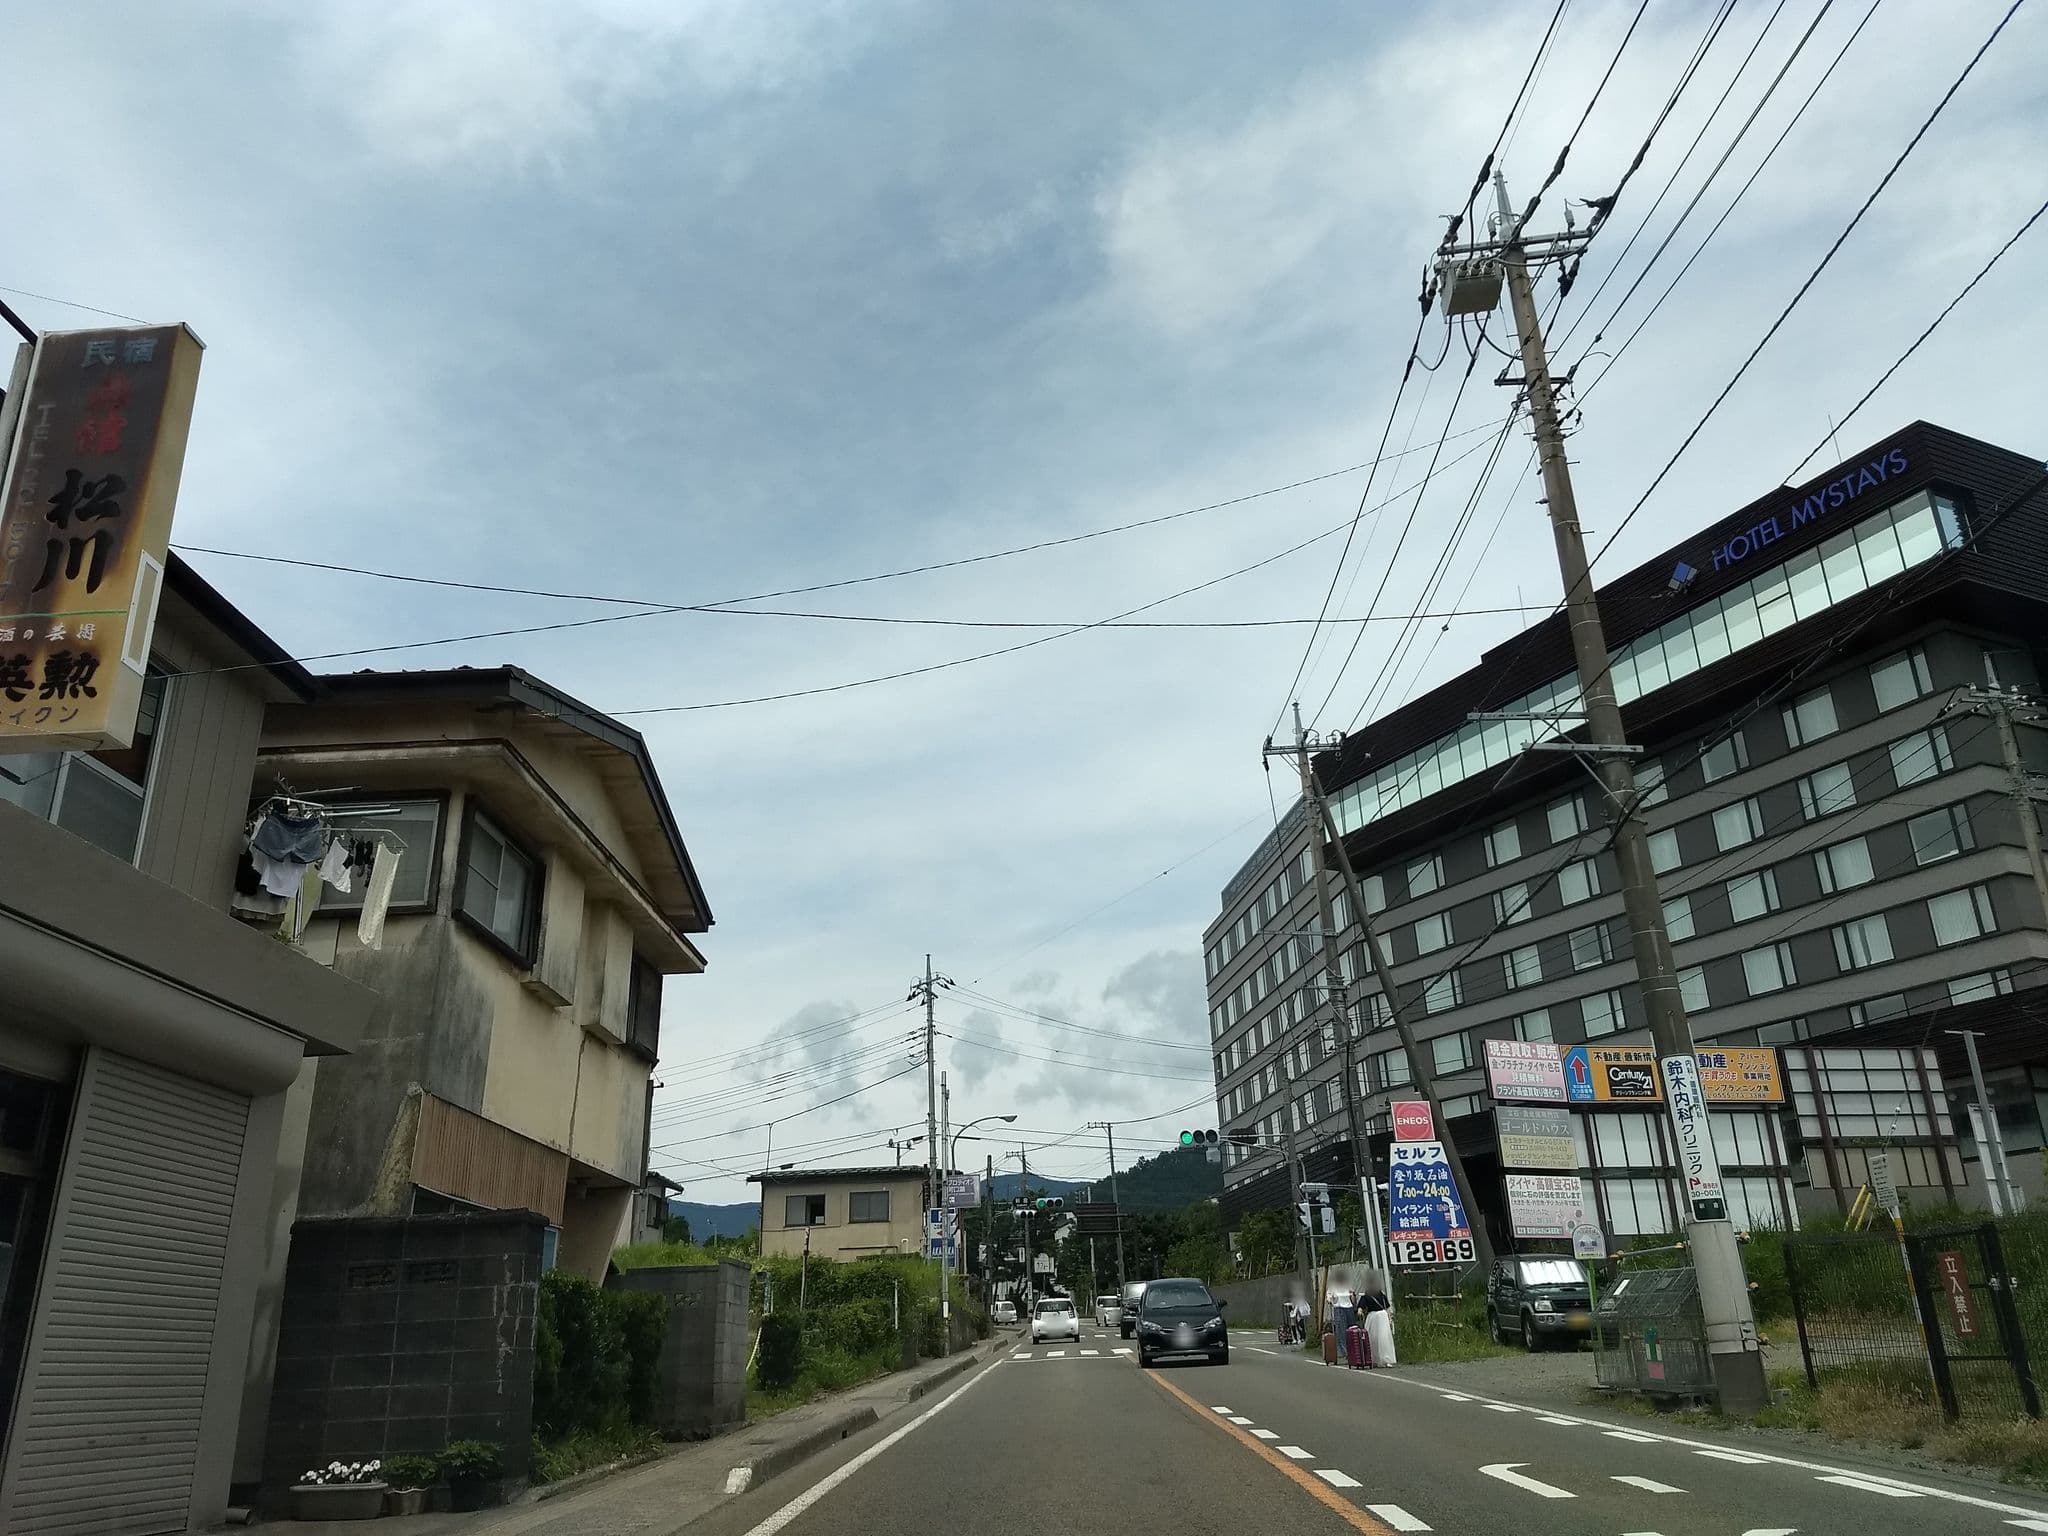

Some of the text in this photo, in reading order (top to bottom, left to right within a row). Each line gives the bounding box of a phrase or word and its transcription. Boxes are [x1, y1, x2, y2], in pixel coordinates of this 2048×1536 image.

[80, 336, 158, 369] 民宿
[1712, 448, 1909, 571] HOTEL MYSTAYS
[31, 467, 128, 594] 松川
[0, 705, 79, 724] イクン
[1488, 1041, 1558, 1059] 現金買取・販売
[1593, 1051, 1623, 1062] 不動産
[1738, 1053, 1767, 1062] アパート
[1737, 1063, 1773, 1071] マンション
[1609, 1067, 1653, 1089] Century 21
[1397, 1116, 1429, 1126] ENEOS
[1667, 1060, 1703, 1175] 鈴木内科クリニック
[1501, 1121, 1570, 1135] ゴールドハウス
[1394, 1147, 1441, 1160] セルフ
[1394, 1168, 1448, 1182] 登り坂石油
[1392, 1204, 1432, 1215] ハイランド
[1399, 1216, 1430, 1229] 給油所
[1393, 1231, 1425, 1240] レギュラー
[1391, 1239, 1474, 1263] 128 69
[1944, 1256, 1973, 1334] 立入禁止
